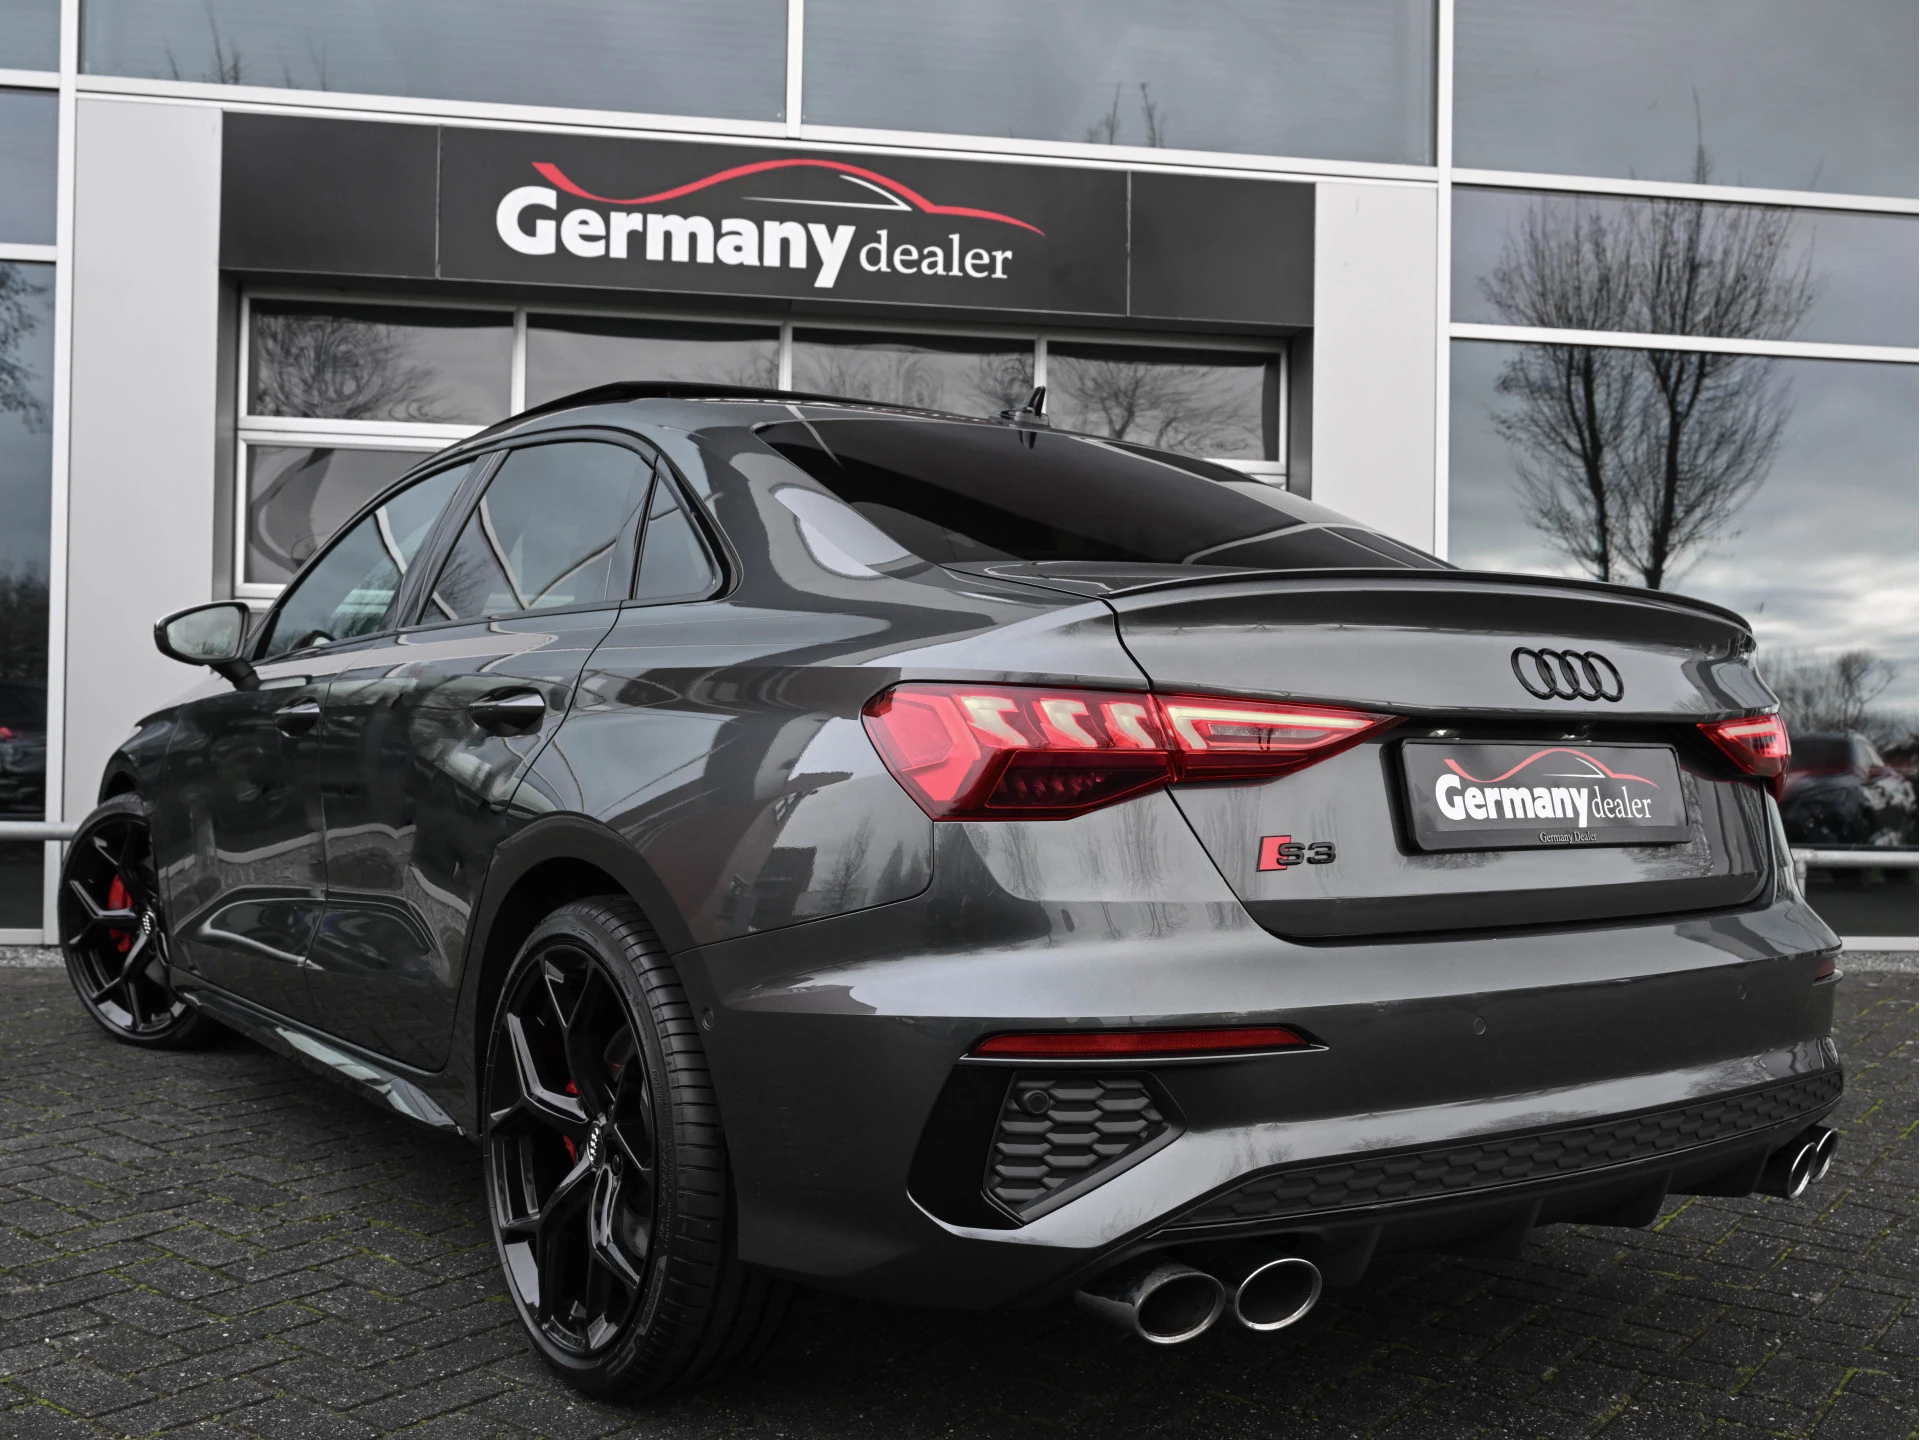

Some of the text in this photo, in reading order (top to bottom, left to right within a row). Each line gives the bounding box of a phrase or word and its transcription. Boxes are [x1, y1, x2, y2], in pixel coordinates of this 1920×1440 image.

[496, 185, 1013, 288] Germany dealer
[1435, 774, 1652, 828] Germany dealer
[1276, 841, 1337, 866] S3
[1539, 830, 1597, 844] Germany Dealer
